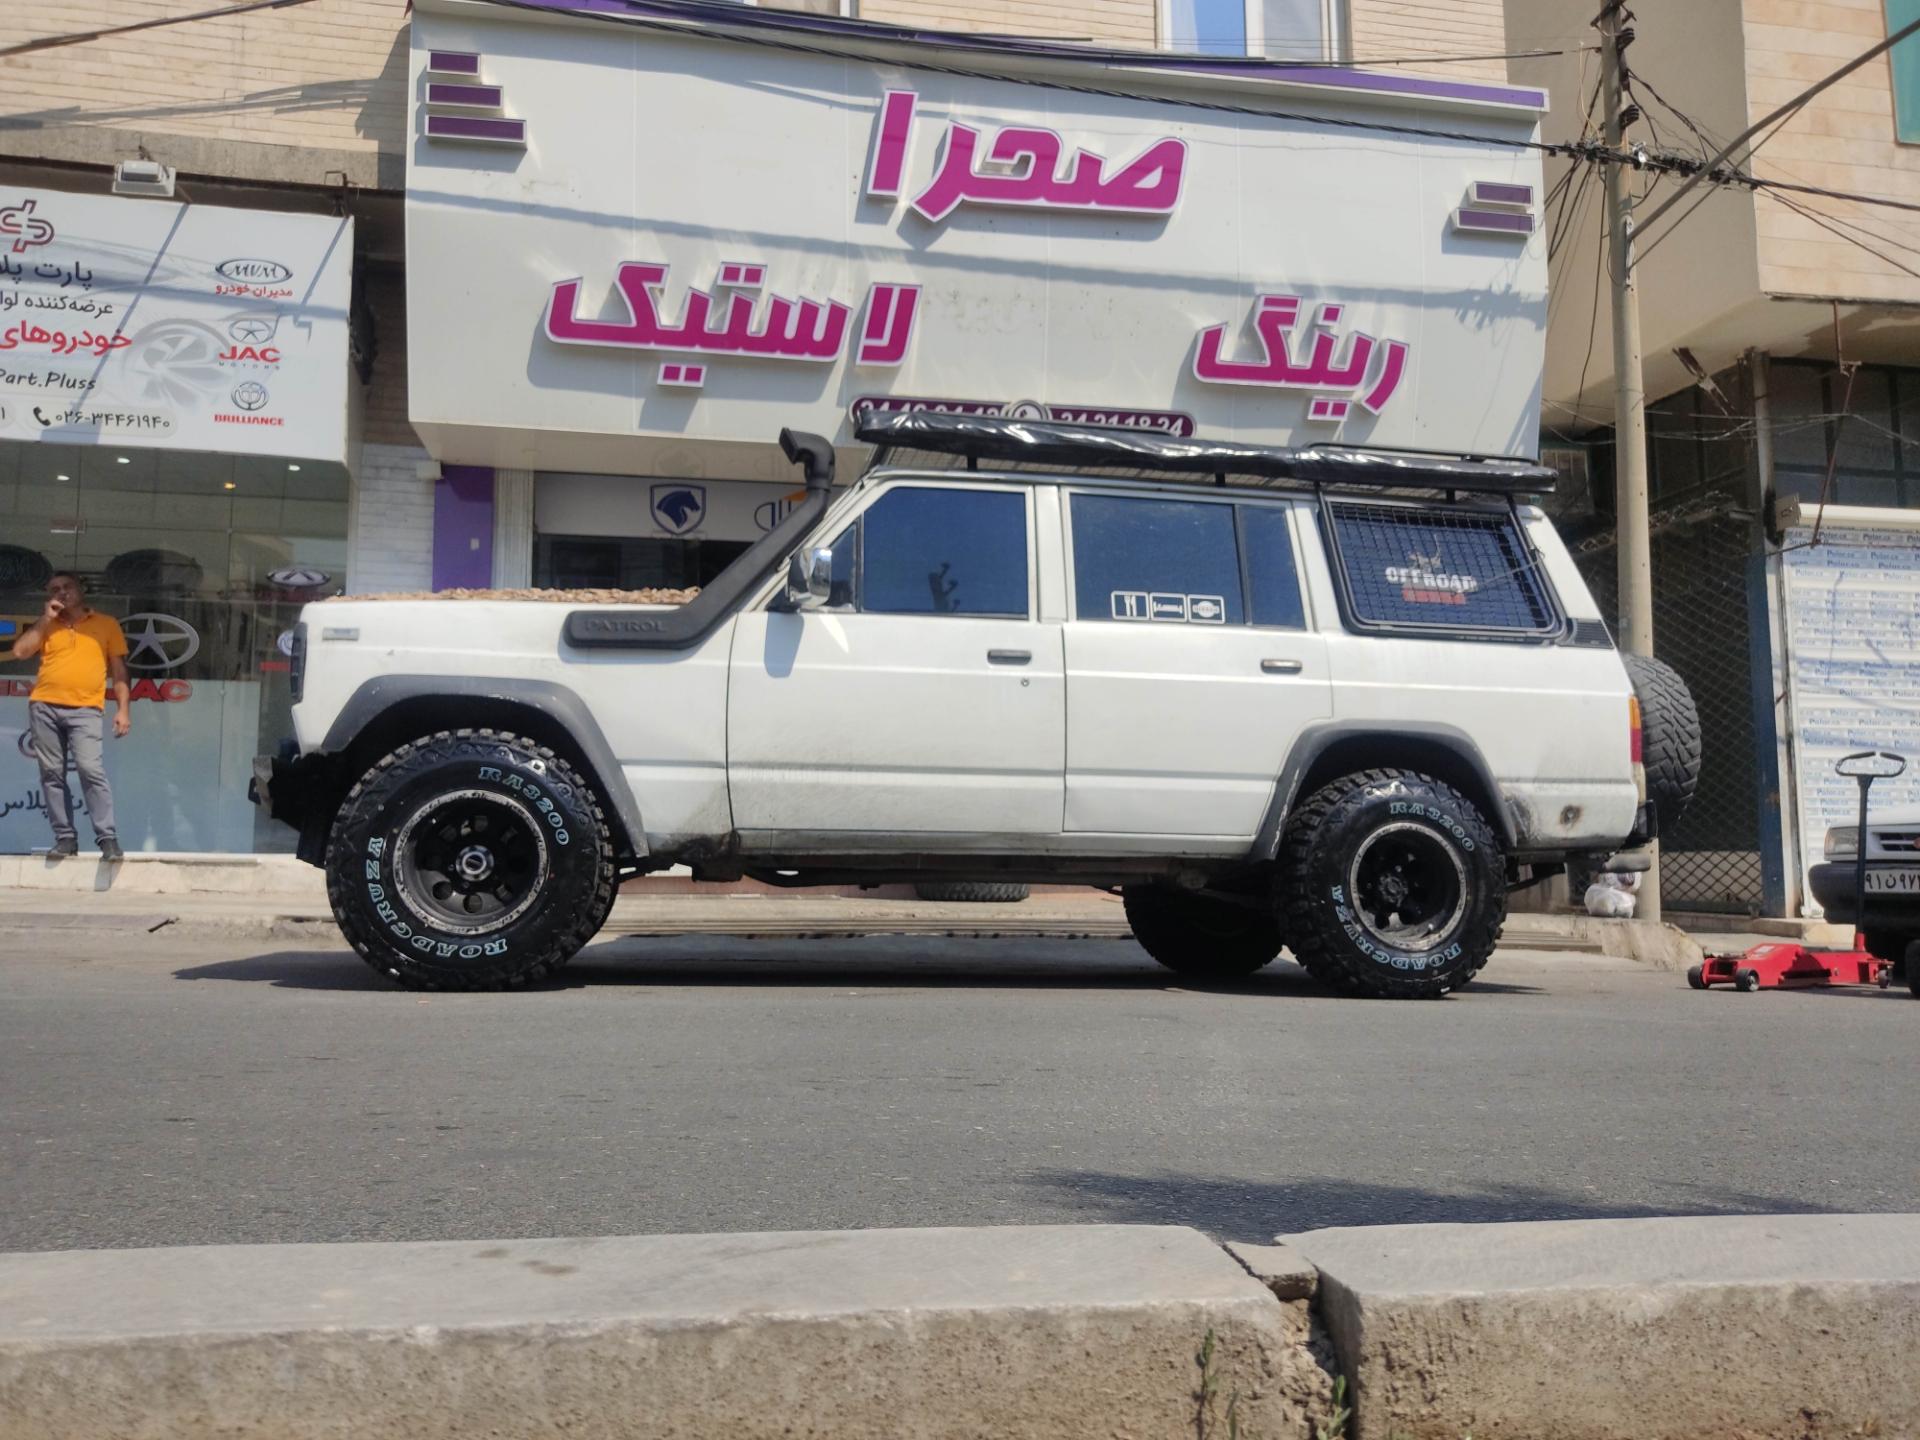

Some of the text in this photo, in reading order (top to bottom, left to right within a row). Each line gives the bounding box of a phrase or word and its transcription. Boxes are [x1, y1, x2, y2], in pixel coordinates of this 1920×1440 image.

[869, 89, 1188, 221] صحرا
[34, 261, 93, 291] پارت
[0, 319, 133, 356] خودروهای
[218, 345, 281, 363] JAC
[545, 261, 1409, 420] رینگ لاستیک
[213, 413, 285, 426] BRILLIANCE
[584, 619, 667, 633] PATROL
[105, 679, 193, 703] AC
[478, 766, 570, 846] RA3200
[1390, 801, 1476, 852] RA3200
[365, 836, 508, 958] ROADCRUZA
[1331, 884, 1462, 971] ROADCRUZA
